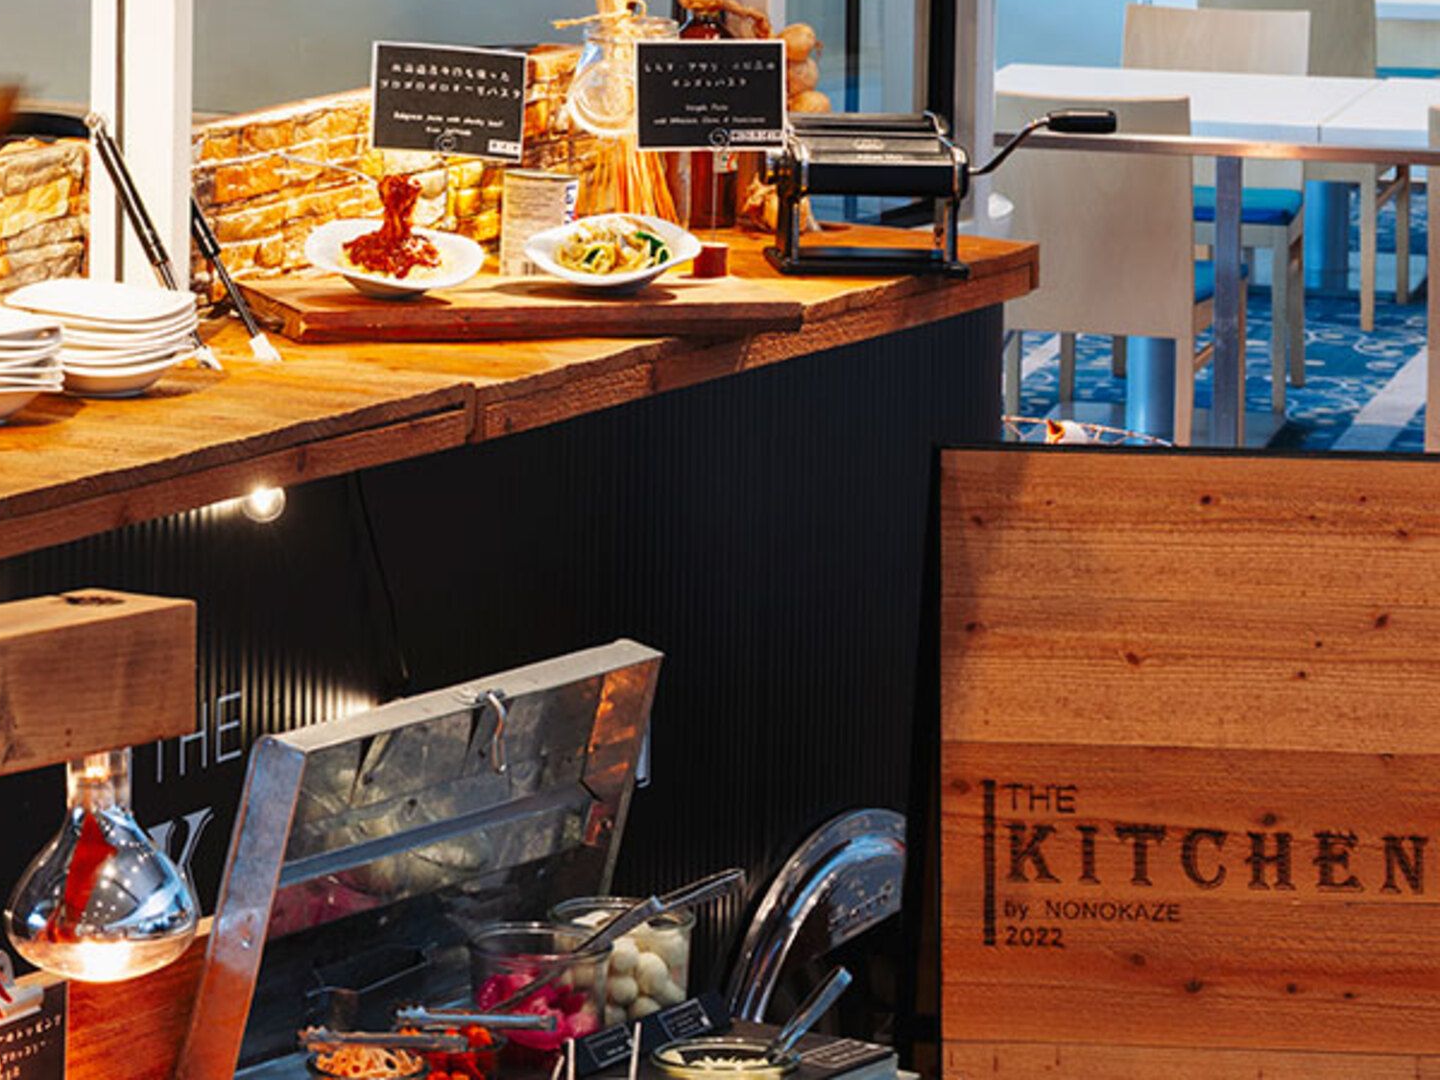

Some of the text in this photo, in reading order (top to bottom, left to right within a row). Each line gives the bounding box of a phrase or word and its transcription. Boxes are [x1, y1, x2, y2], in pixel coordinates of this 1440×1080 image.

[1002, 782, 1078, 814] THE
[1001, 823, 1429, 894] KITCHEN
[1004, 899, 1181, 922] by NONOKAZE
[1004, 927, 1065, 948] 2022
